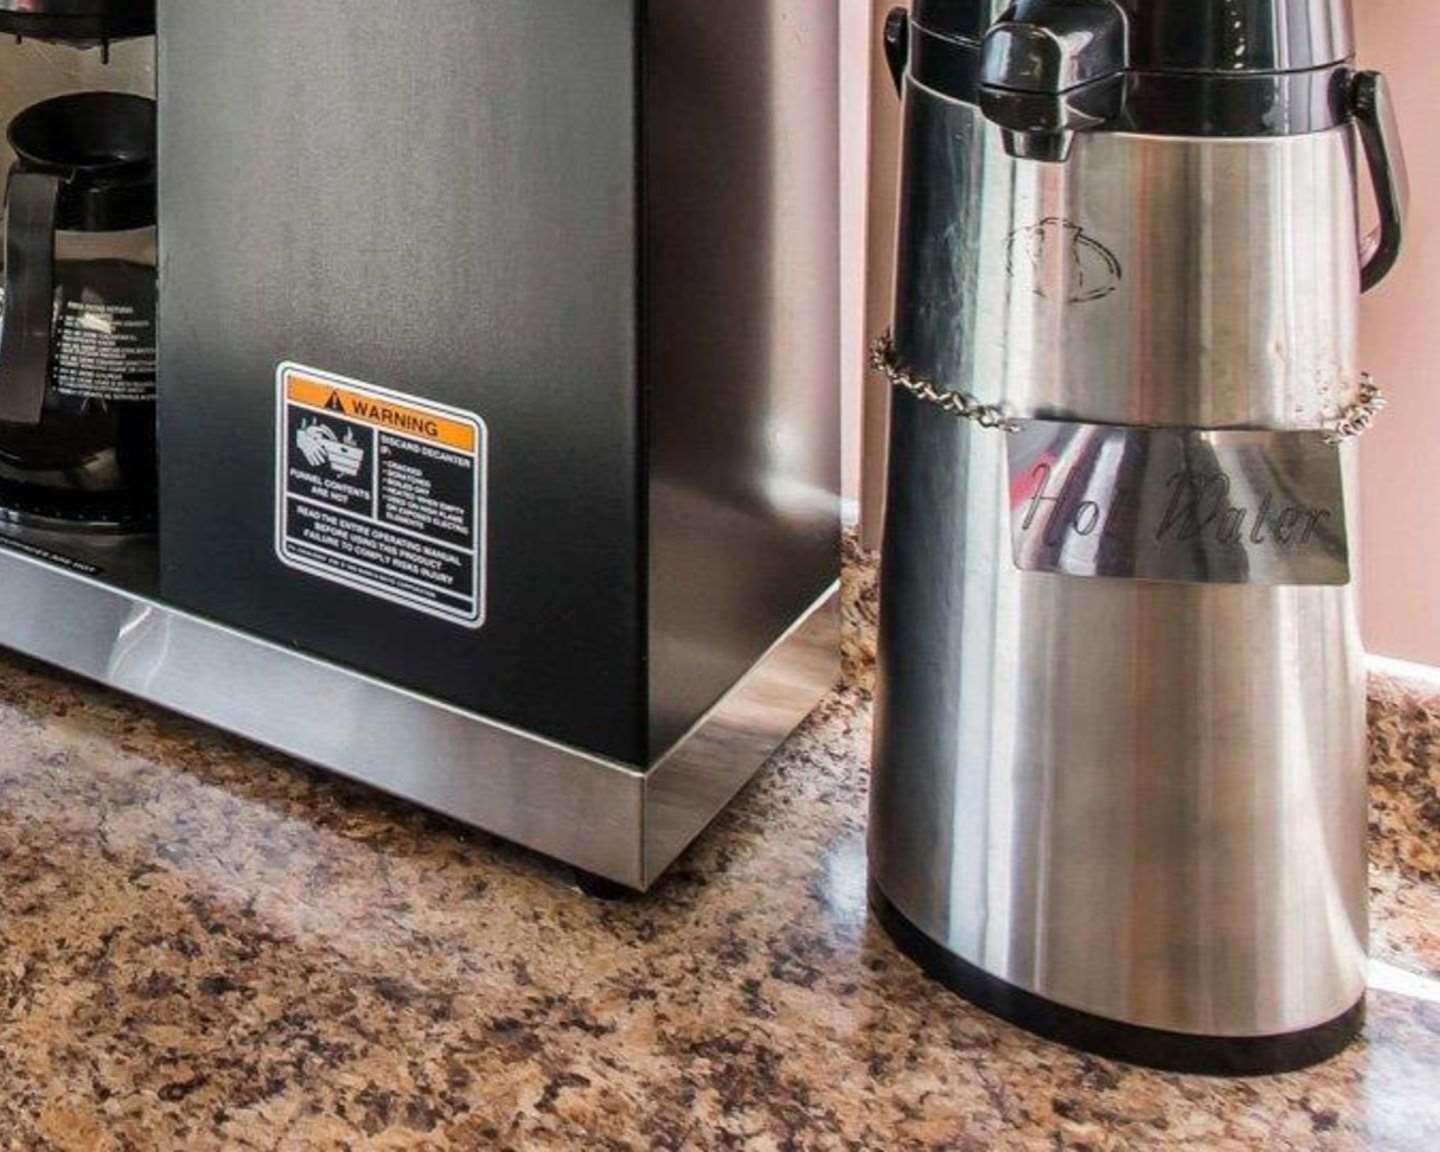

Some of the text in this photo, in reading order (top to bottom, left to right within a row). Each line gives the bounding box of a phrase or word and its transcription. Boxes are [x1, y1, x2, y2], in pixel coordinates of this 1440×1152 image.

[351, 399, 438, 437] WARNING
[324, 479, 370, 500] CONTENTS
[1023, 462, 1331, 546] Ho Water
[303, 528, 339, 547] FAILURE
[340, 540, 352, 552] TO
[354, 546, 390, 564] COMPLY
[371, 530, 421, 552] OPERATING
[399, 549, 442, 570] PRODUCT
